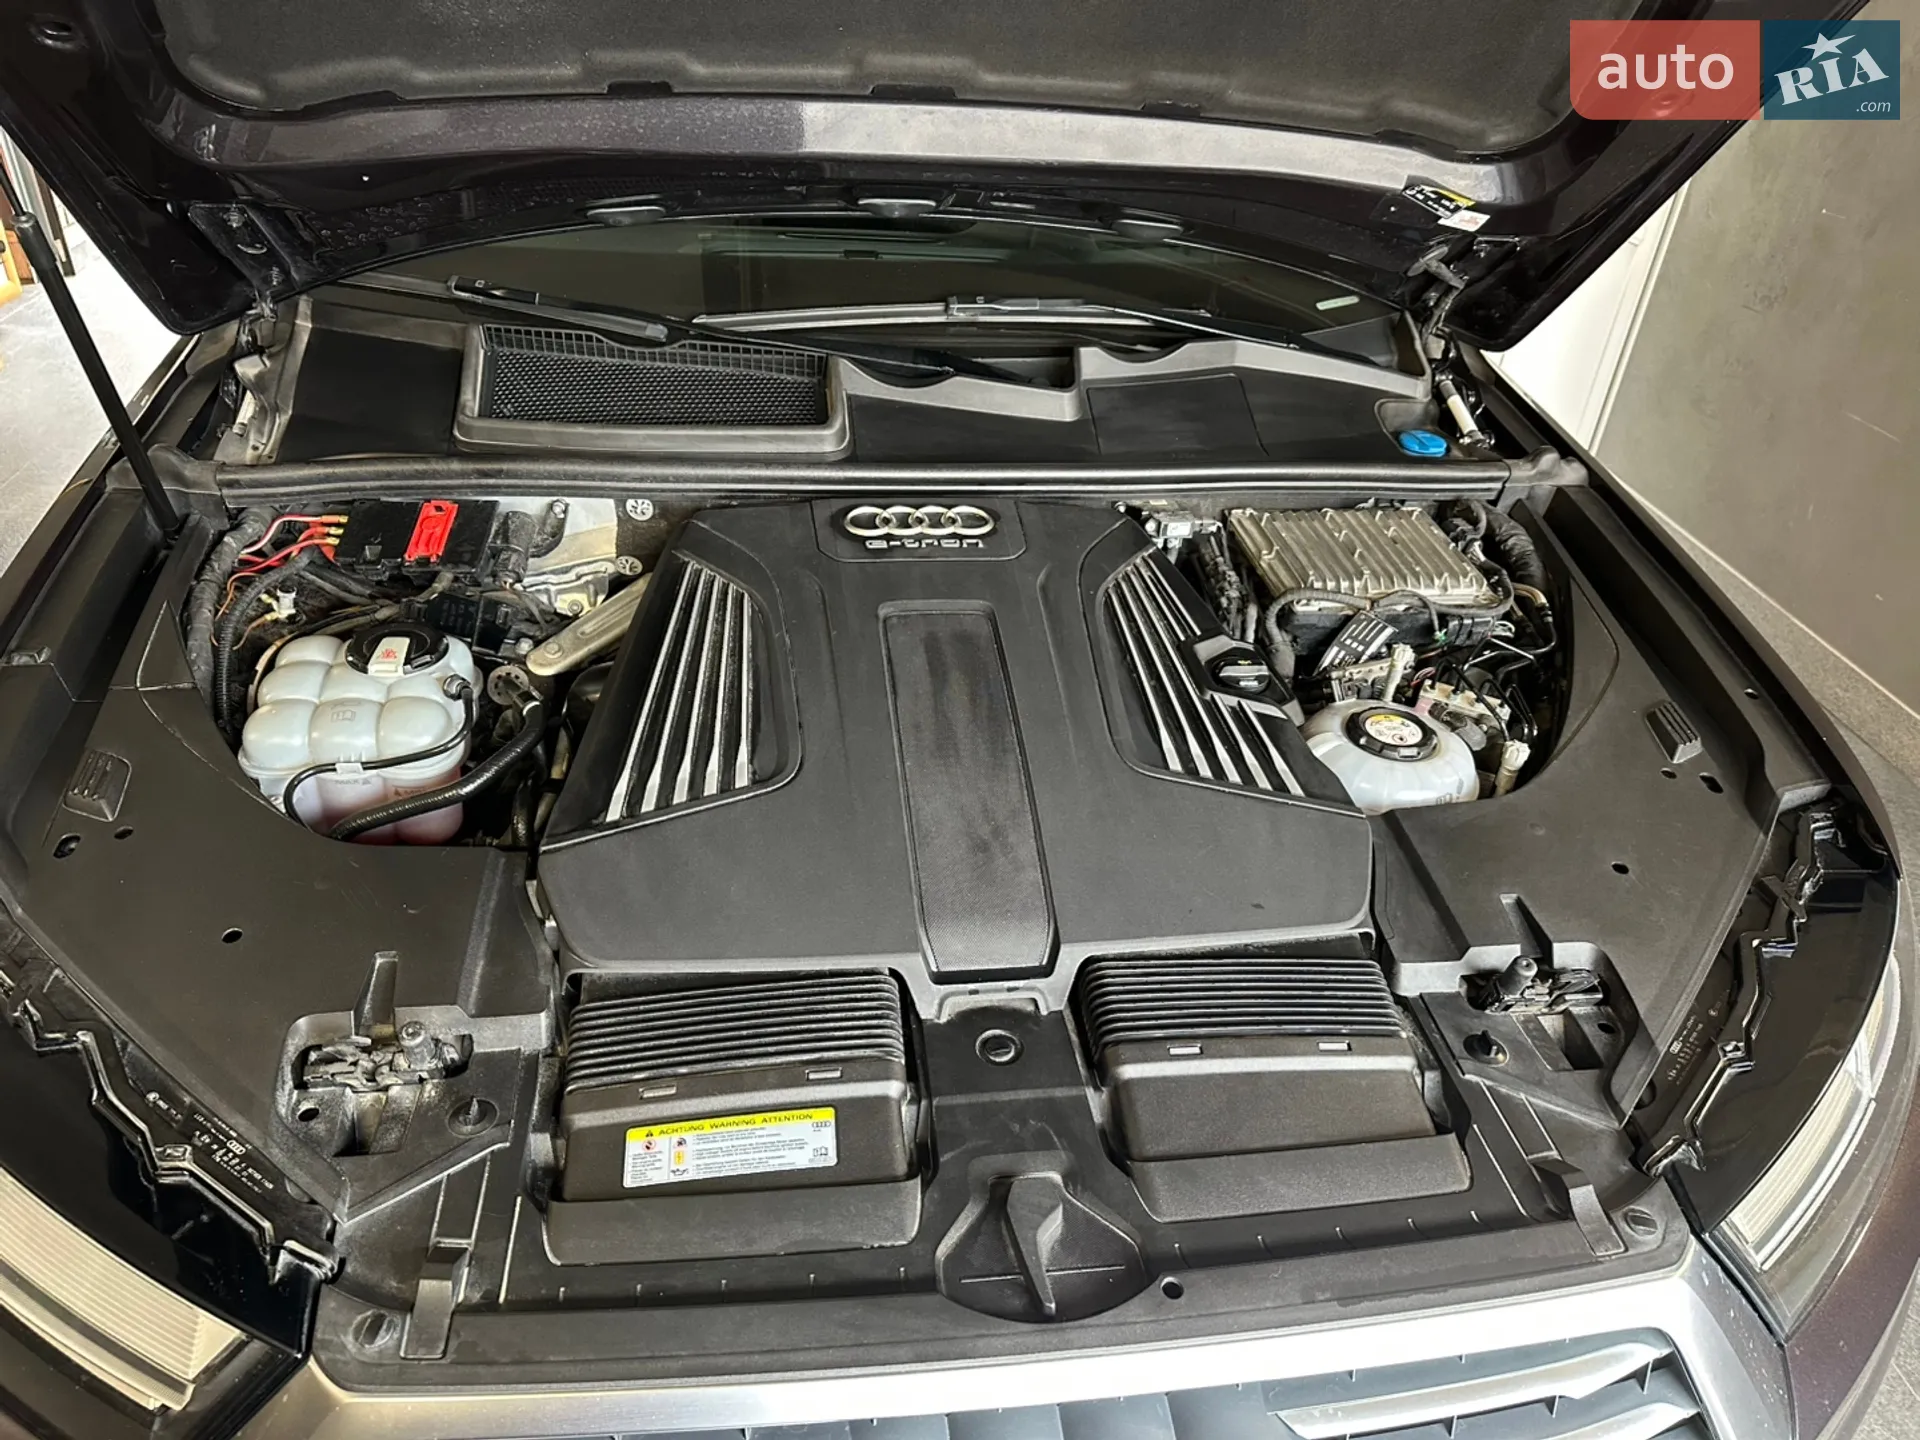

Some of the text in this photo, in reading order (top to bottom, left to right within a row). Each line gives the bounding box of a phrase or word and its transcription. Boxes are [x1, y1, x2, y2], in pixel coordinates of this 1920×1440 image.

[658, 1124, 705, 1136] ACHTUNG
[709, 1118, 757, 1130] WARNING
[761, 1113, 814, 1125] ATTENTION
